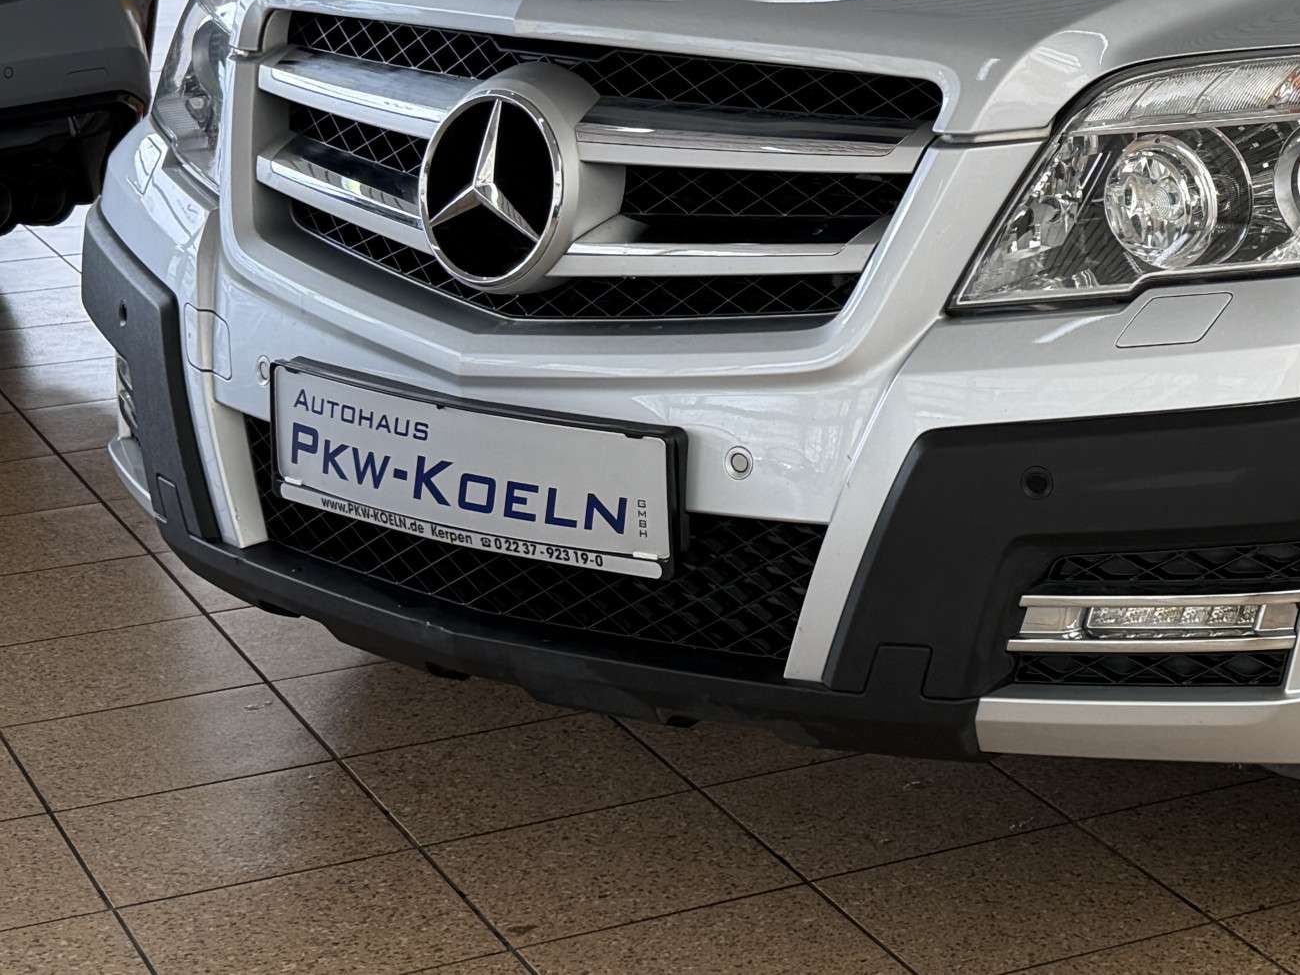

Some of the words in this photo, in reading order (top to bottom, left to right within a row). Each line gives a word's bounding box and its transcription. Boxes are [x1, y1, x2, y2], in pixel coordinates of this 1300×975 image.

[293, 389, 429, 441] AUTOHAUS
[290, 422, 628, 535] PKW-KOELN
[321, 497, 425, 534] www.PKW-KOELN.de
[430, 525, 473, 546] Kerpen
